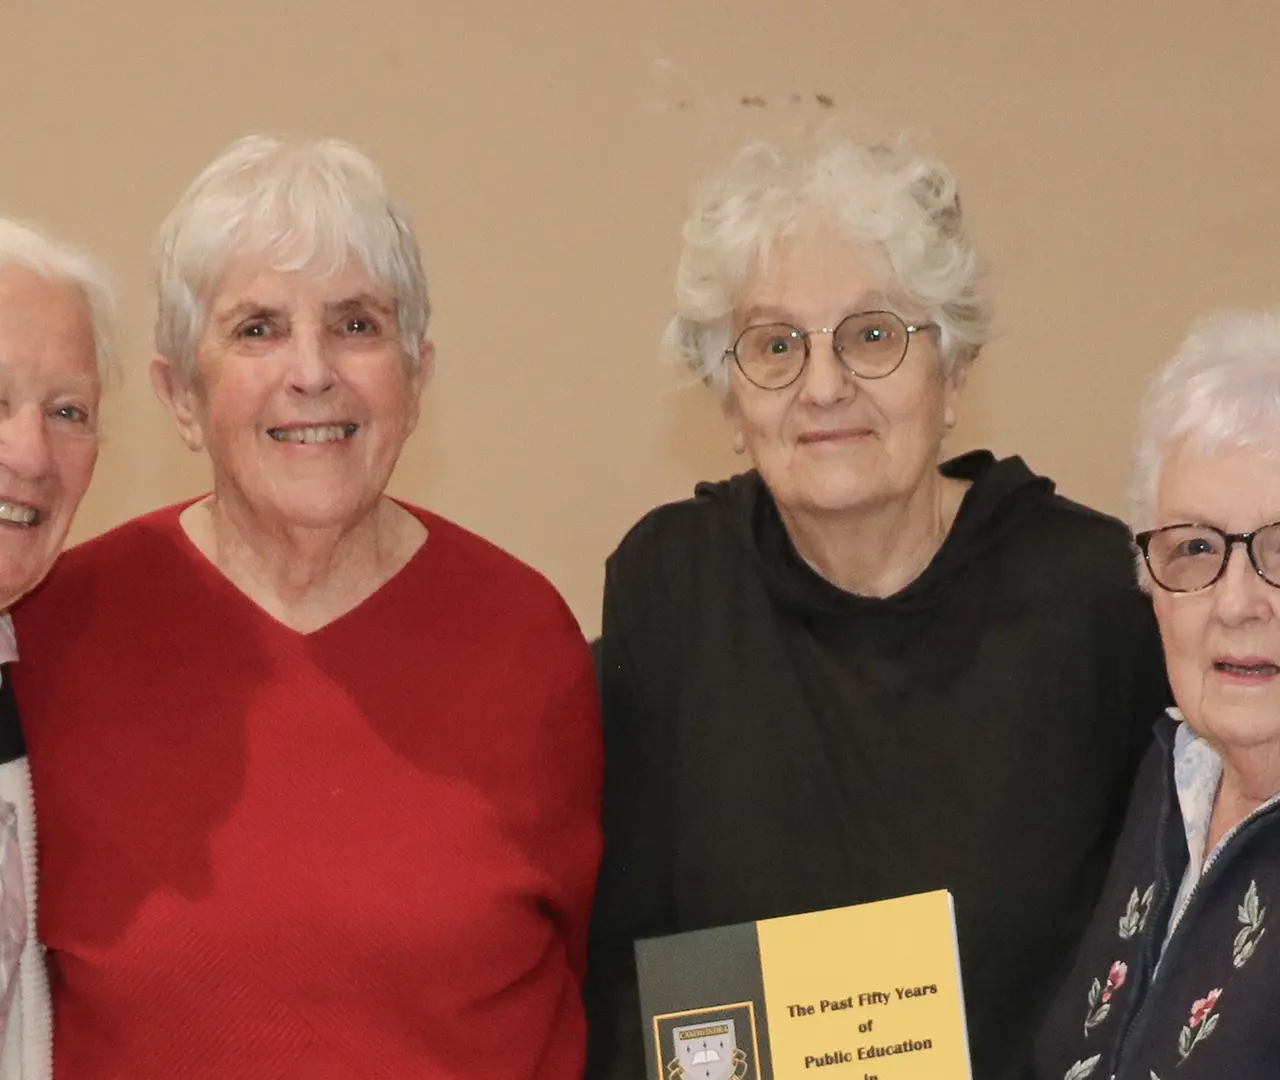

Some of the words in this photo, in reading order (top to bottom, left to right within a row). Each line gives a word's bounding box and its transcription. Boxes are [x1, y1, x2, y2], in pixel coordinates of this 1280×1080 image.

[786, 1004, 815, 1018] The
[820, 996, 853, 1013] Past
[858, 992, 891, 1006] Fifty
[895, 984, 938, 1000] Years
[858, 1019, 873, 1033] of
[804, 1051, 852, 1069] Public
[857, 1039, 932, 1060] Education
